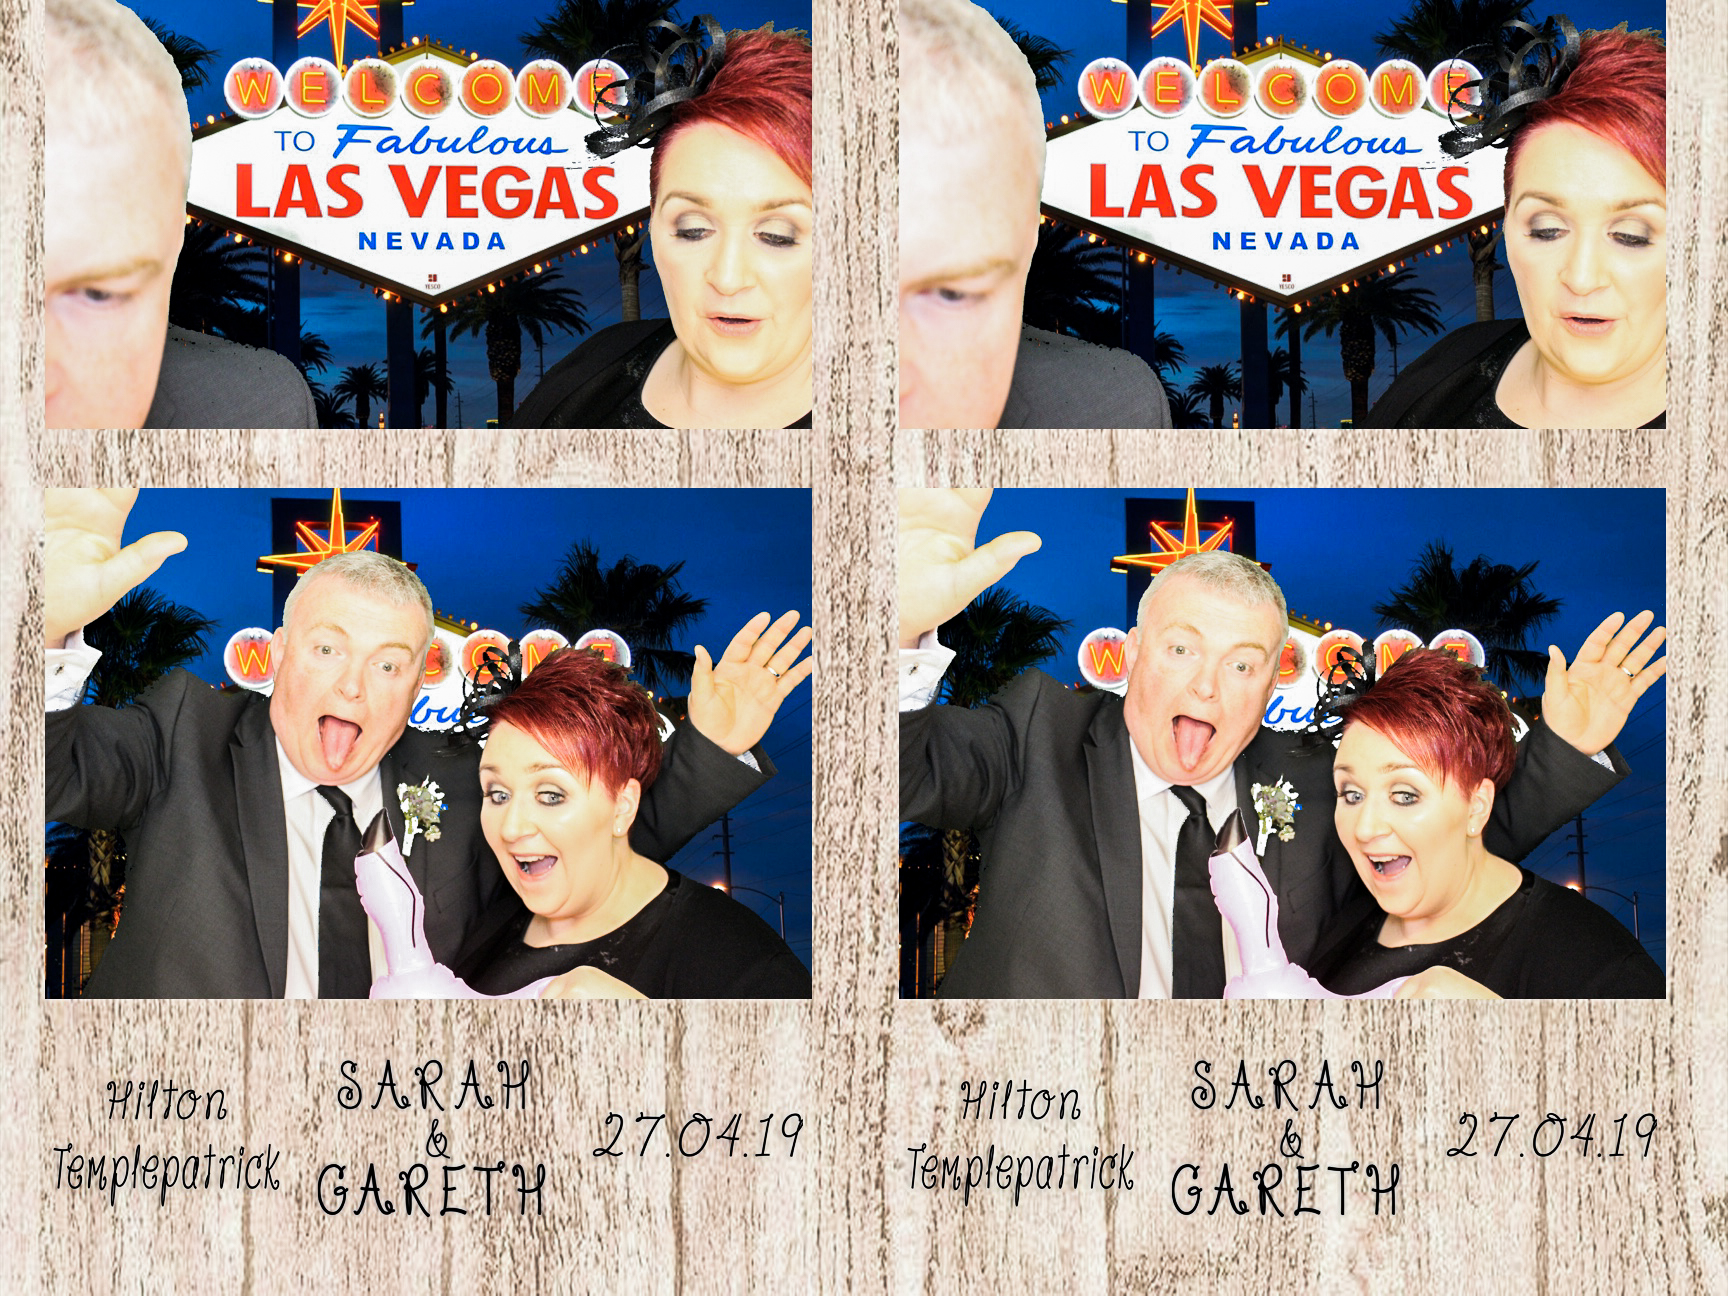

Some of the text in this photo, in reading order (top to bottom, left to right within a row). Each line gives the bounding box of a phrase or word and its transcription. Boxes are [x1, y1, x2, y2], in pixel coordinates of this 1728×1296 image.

[235, 70, 613, 106] WELCOME
[1089, 70, 1467, 106] WELCOME
[274, 123, 569, 159] TO Fabulous
[1128, 123, 1423, 159] TO Fabulous
[235, 163, 619, 220] LAS VEGAS
[1089, 163, 1473, 220] LAS VEGAS
[358, 231, 506, 251] NEVADA
[1212, 231, 1360, 251] NEVADA
